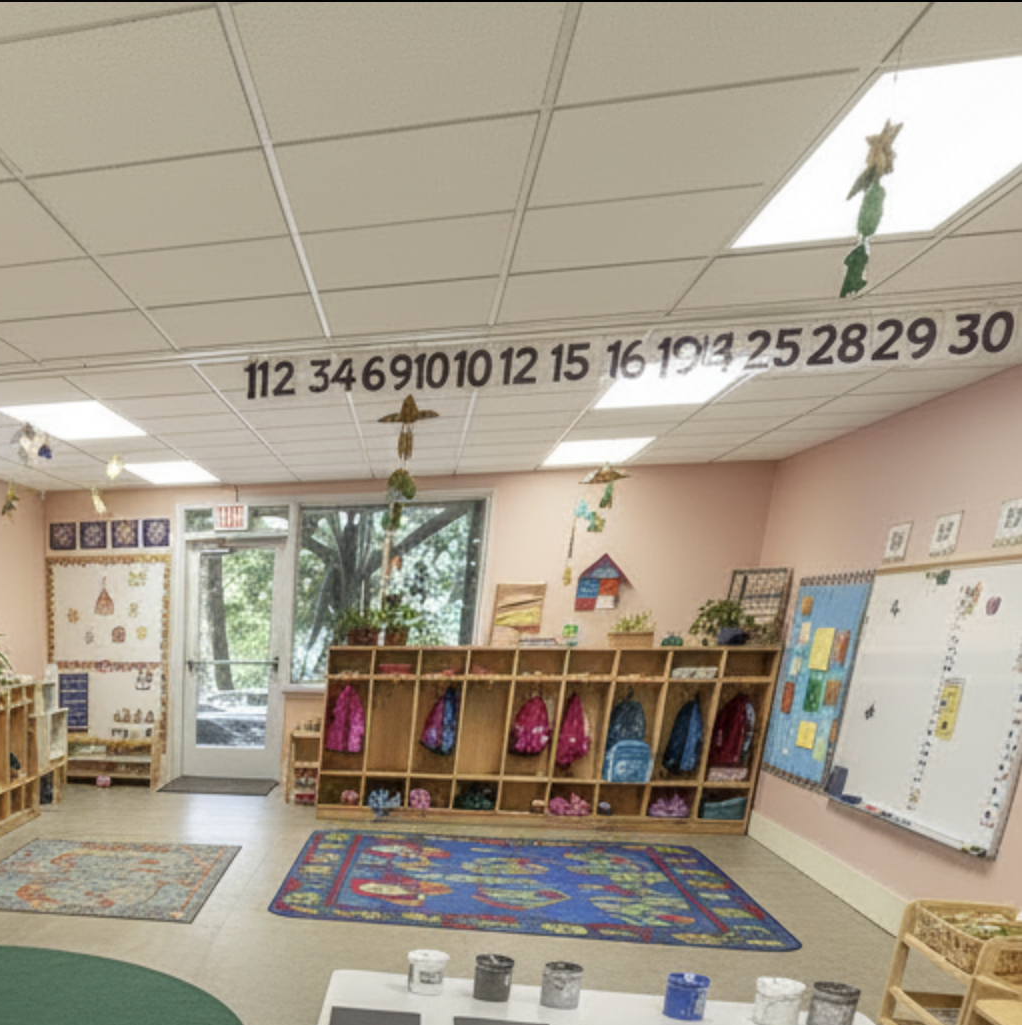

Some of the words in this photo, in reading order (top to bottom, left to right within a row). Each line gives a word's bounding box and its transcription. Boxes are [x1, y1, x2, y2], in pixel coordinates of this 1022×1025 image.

[500, 346, 538, 385] 12
[550, 342, 590, 382] 15
[606, 339, 646, 379] 16
[806, 323, 867, 366] 28
[871, 318, 937, 361] 29
[948, 311, 1015, 355] 30
